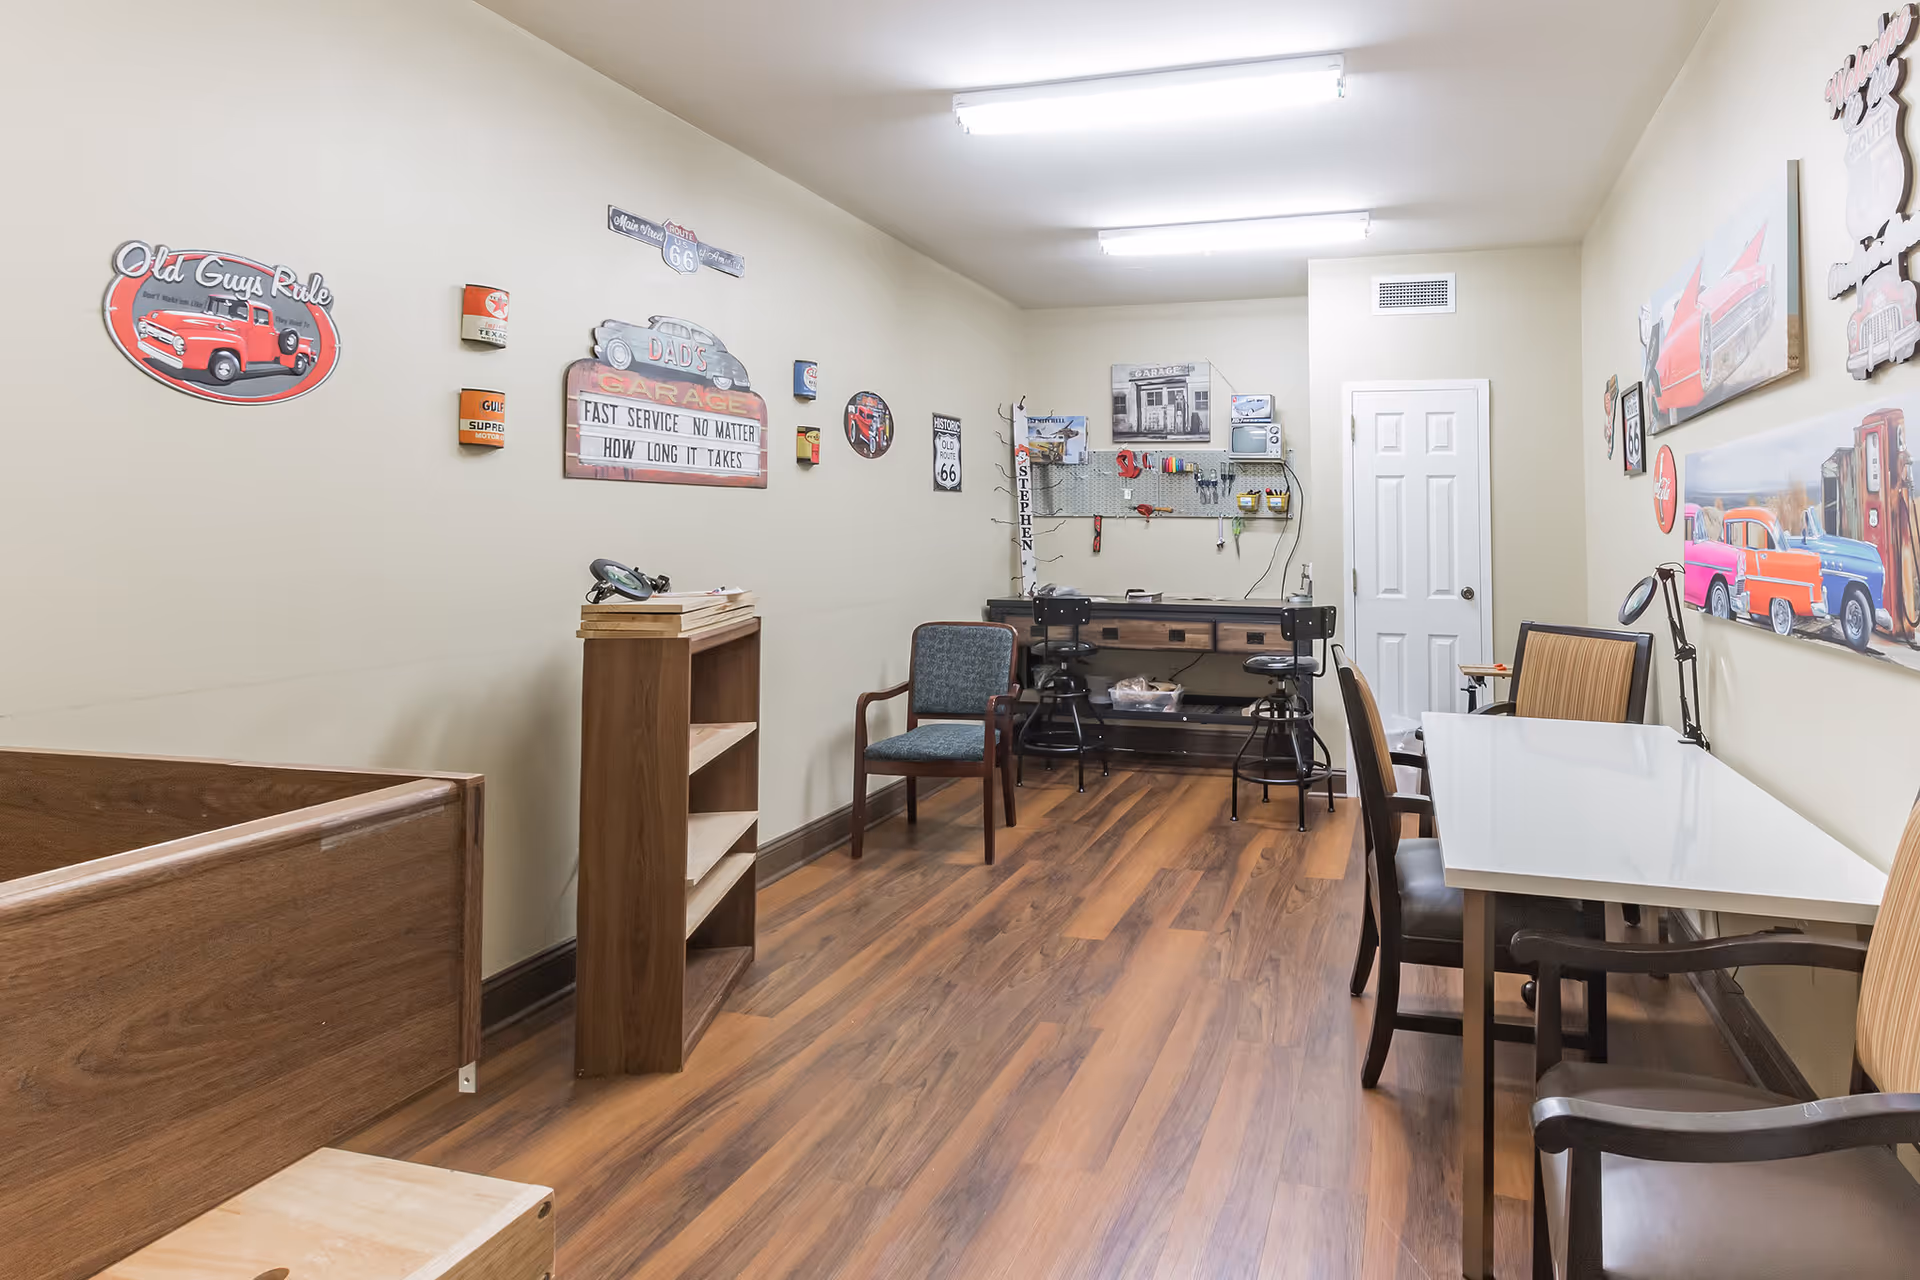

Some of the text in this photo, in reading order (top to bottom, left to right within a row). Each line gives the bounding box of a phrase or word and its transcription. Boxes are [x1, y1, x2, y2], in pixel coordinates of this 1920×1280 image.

[613, 214, 665, 242] Main Street
[669, 224, 694, 241] ROUTE
[674, 237, 688, 249] US
[669, 244, 694, 271] 66
[115, 241, 332, 306] Old Guys Rule
[478, 329, 507, 339] TEXAC
[648, 336, 707, 372] DAD'S
[1135, 366, 1180, 377] GARAGE
[599, 373, 748, 414] GARAGE
[584, 400, 755, 442] FAST SERVICE NO MATTER
[934, 417, 960, 432] HISTORIC
[475, 432, 500, 440] MOTOR
[941, 440, 954, 450] OLD
[1628, 421, 1640, 456] 66
[603, 437, 743, 469] HOW LONG IT TAKES
[940, 451, 956, 460] ROUTE
[940, 463, 956, 482] 66
[1018, 466, 1033, 550] STEPHEN
